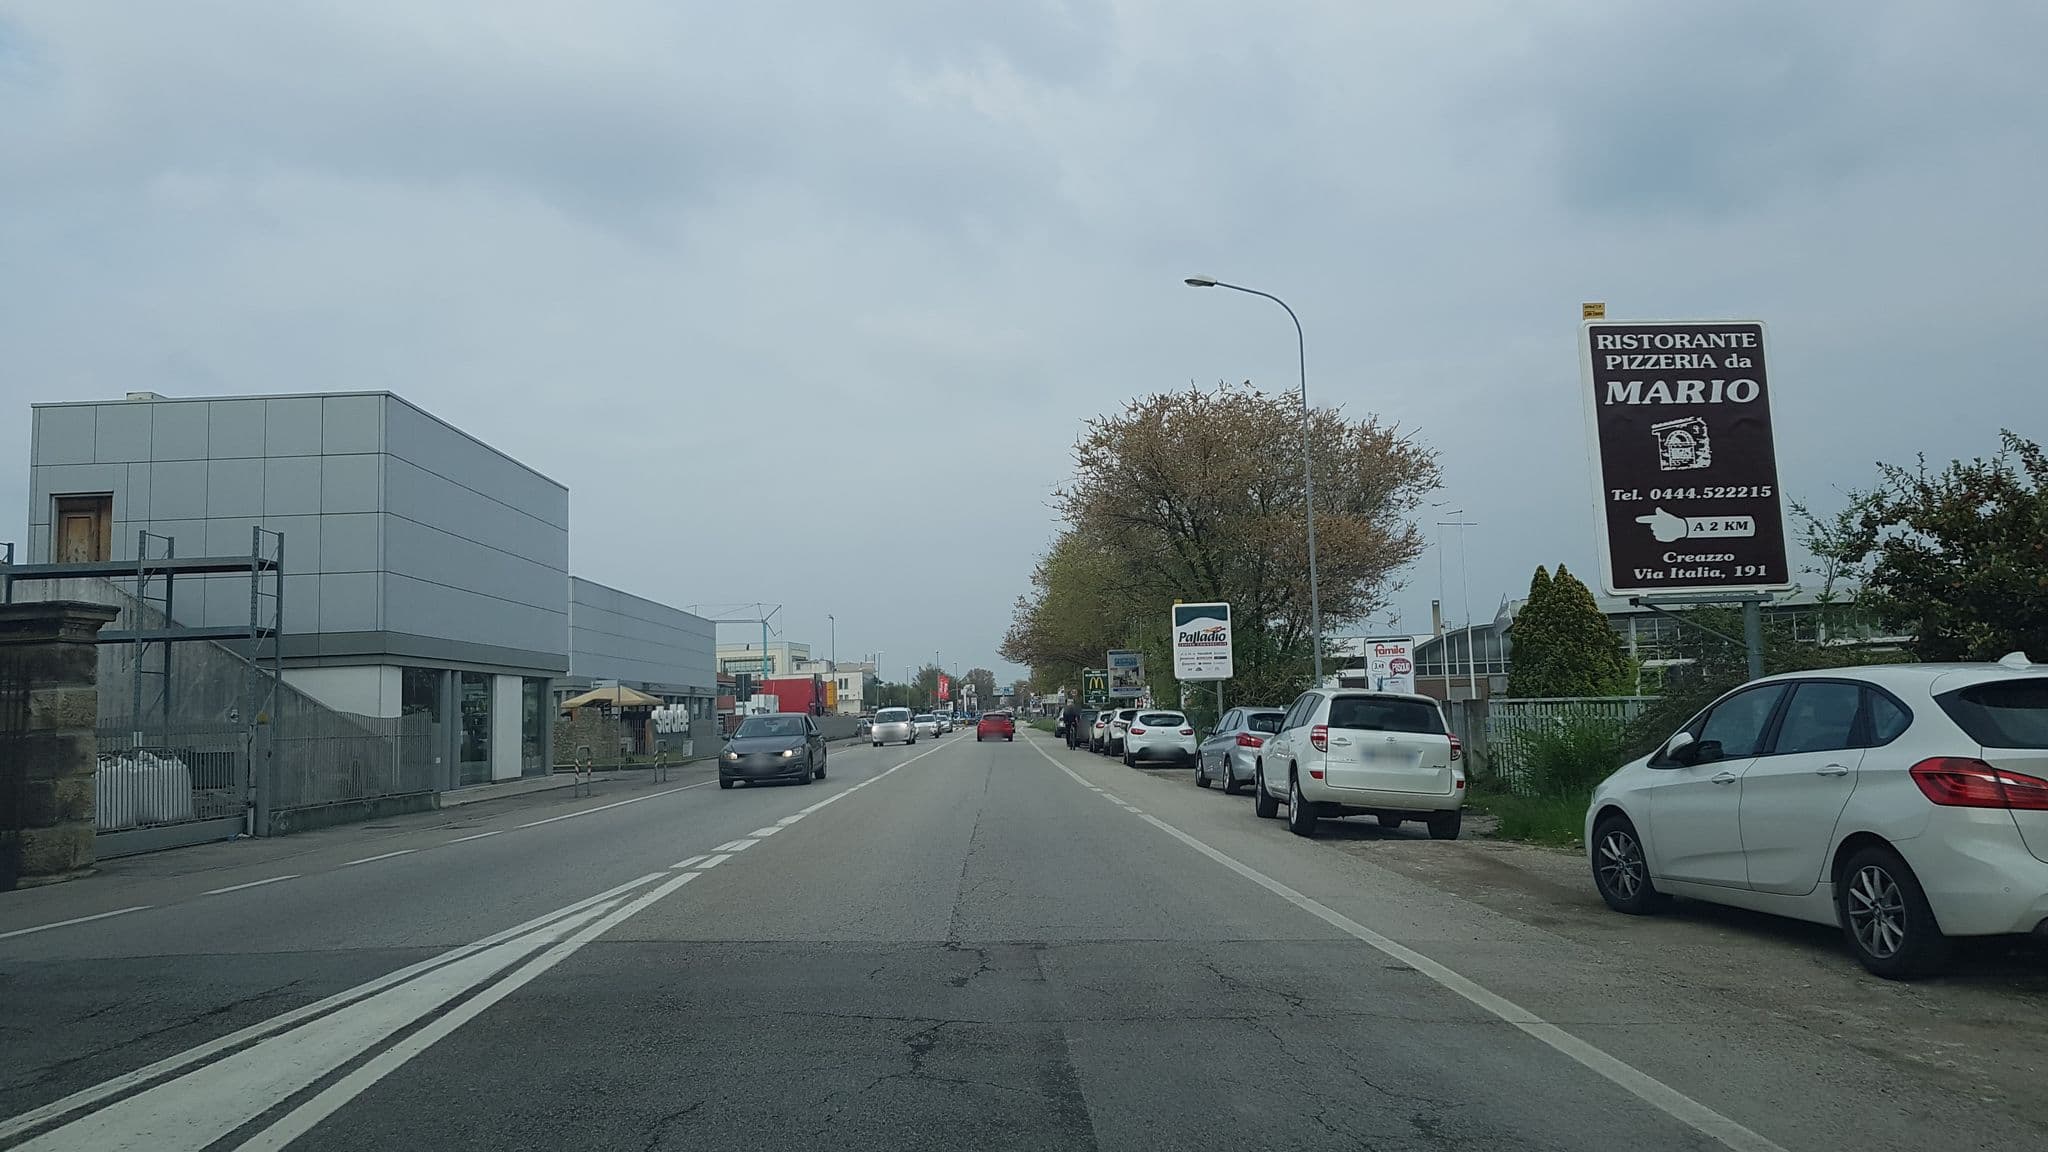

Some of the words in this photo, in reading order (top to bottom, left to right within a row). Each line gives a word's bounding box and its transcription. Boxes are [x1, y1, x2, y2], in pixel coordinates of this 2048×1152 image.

[1597, 332, 1758, 350] RISTORANTE
[1605, 354, 1718, 370] PIZZERIA
[1724, 352, 1753, 369] da
[1604, 378, 1761, 406] MARIO
[1611, 488, 1643, 501] Tel.
[1649, 485, 1773, 501] 0444.522215
[1693, 521, 1705, 532] A
[1709, 520, 1719, 531] 2
[1723, 520, 1749, 532] KM
[1663, 551, 1735, 564] Creazzo
[1634, 567, 1665, 580] Via
[1670, 566, 1727, 580] Italia,
[1734, 564, 1768, 577] 191
[1179, 630, 1227, 644] Palladio
[1375, 643, 1405, 657] famila
